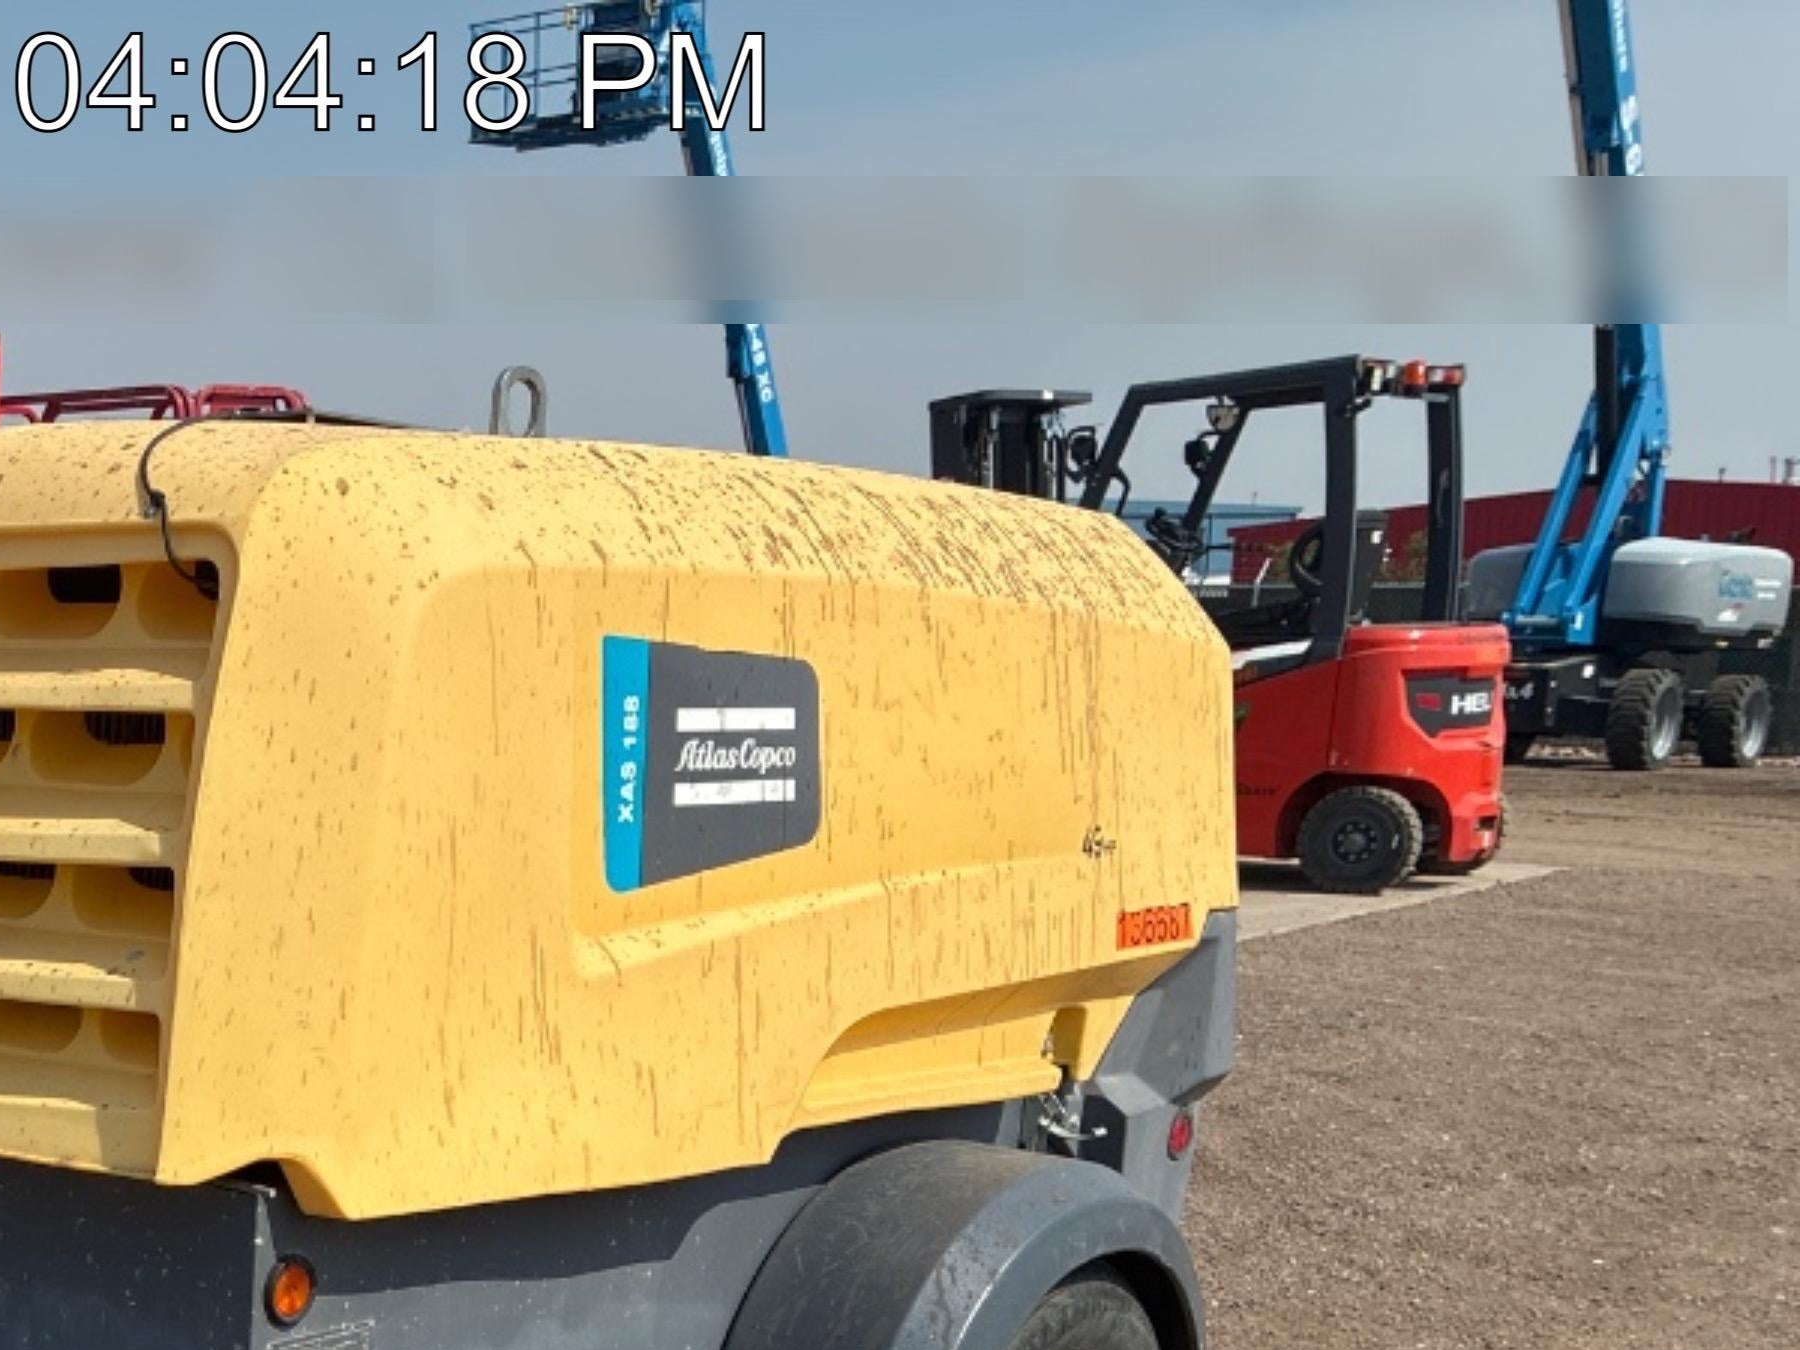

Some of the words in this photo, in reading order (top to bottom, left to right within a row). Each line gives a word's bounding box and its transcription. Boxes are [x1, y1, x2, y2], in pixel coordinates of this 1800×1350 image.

[674, 737, 740, 773] Atlas
[738, 736, 797, 775] Copco
[617, 760, 638, 824] XAS
